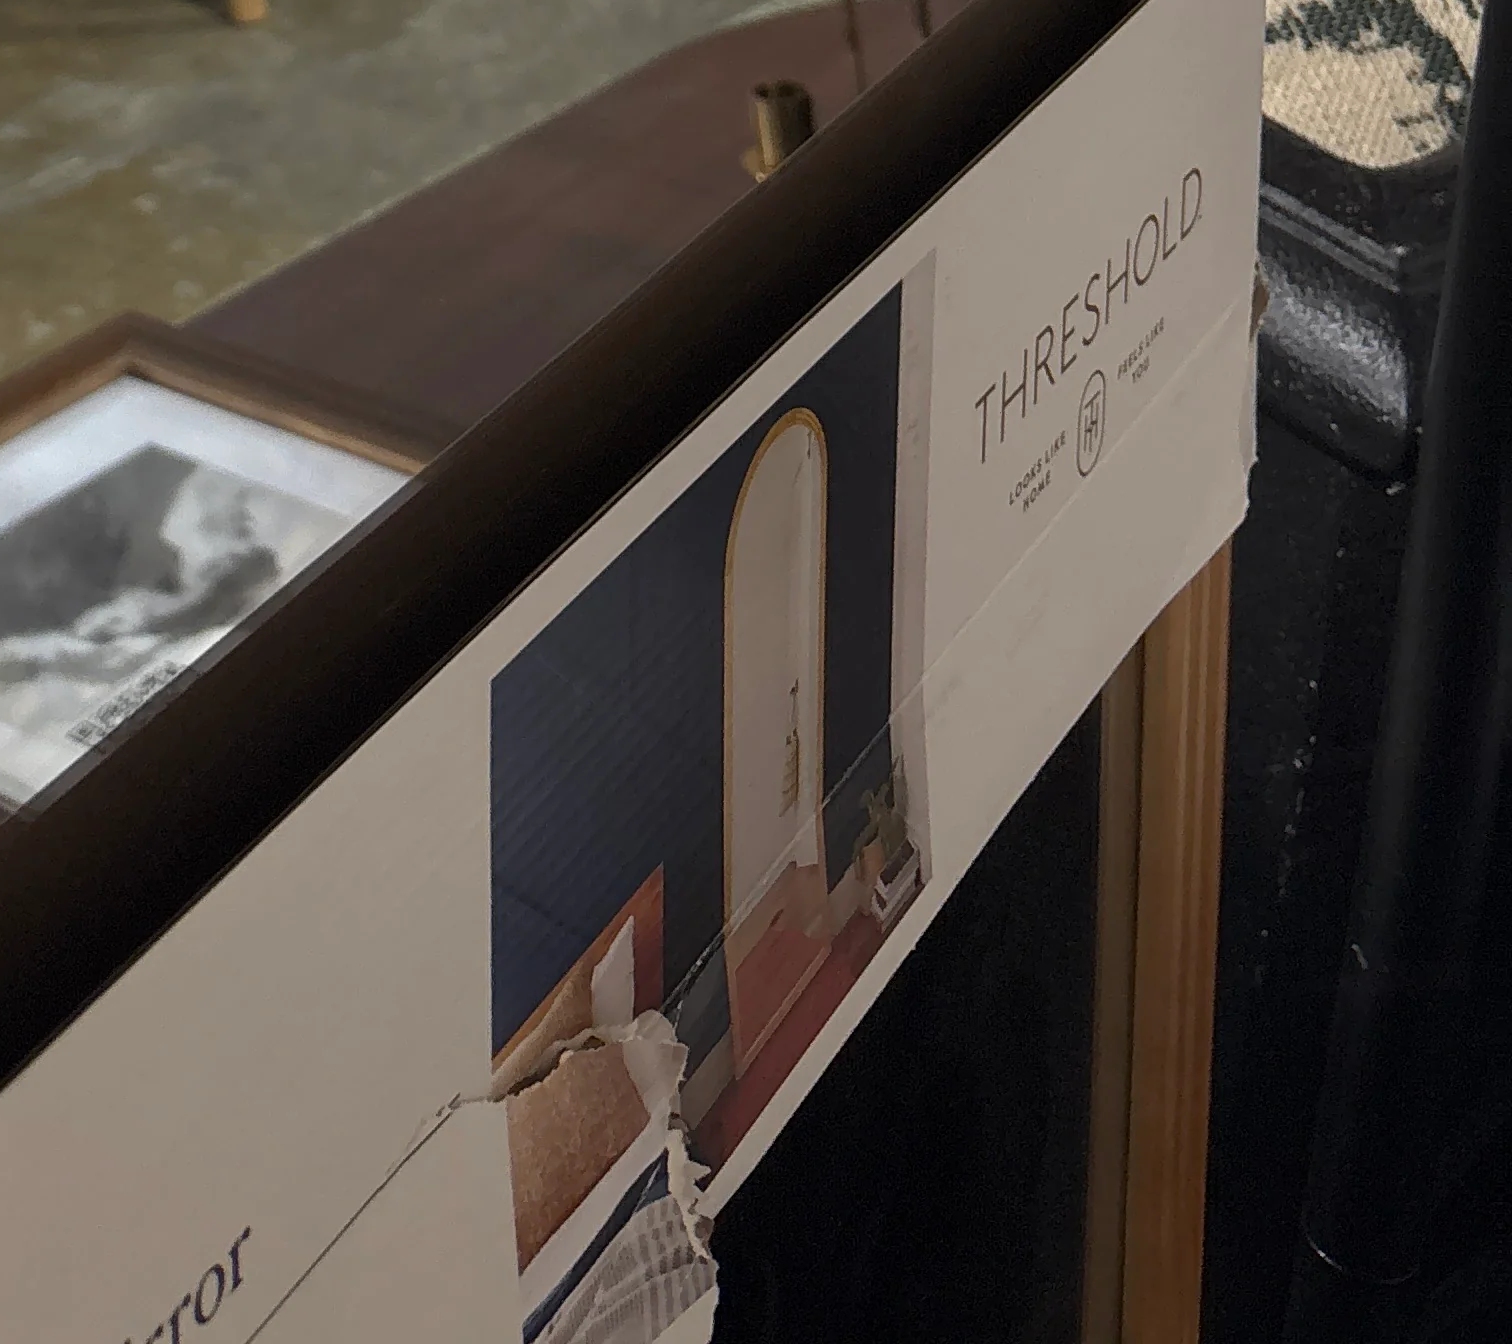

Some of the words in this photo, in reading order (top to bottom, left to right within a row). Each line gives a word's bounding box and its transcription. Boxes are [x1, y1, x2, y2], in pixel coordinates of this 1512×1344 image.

[975, 166, 1203, 464] THRESHOLD
[1009, 457, 1042, 505] LOOKS
[1044, 430, 1066, 464] LIKE
[1023, 469, 1050, 513] HOME
[124, 1226, 251, 1344] ror
